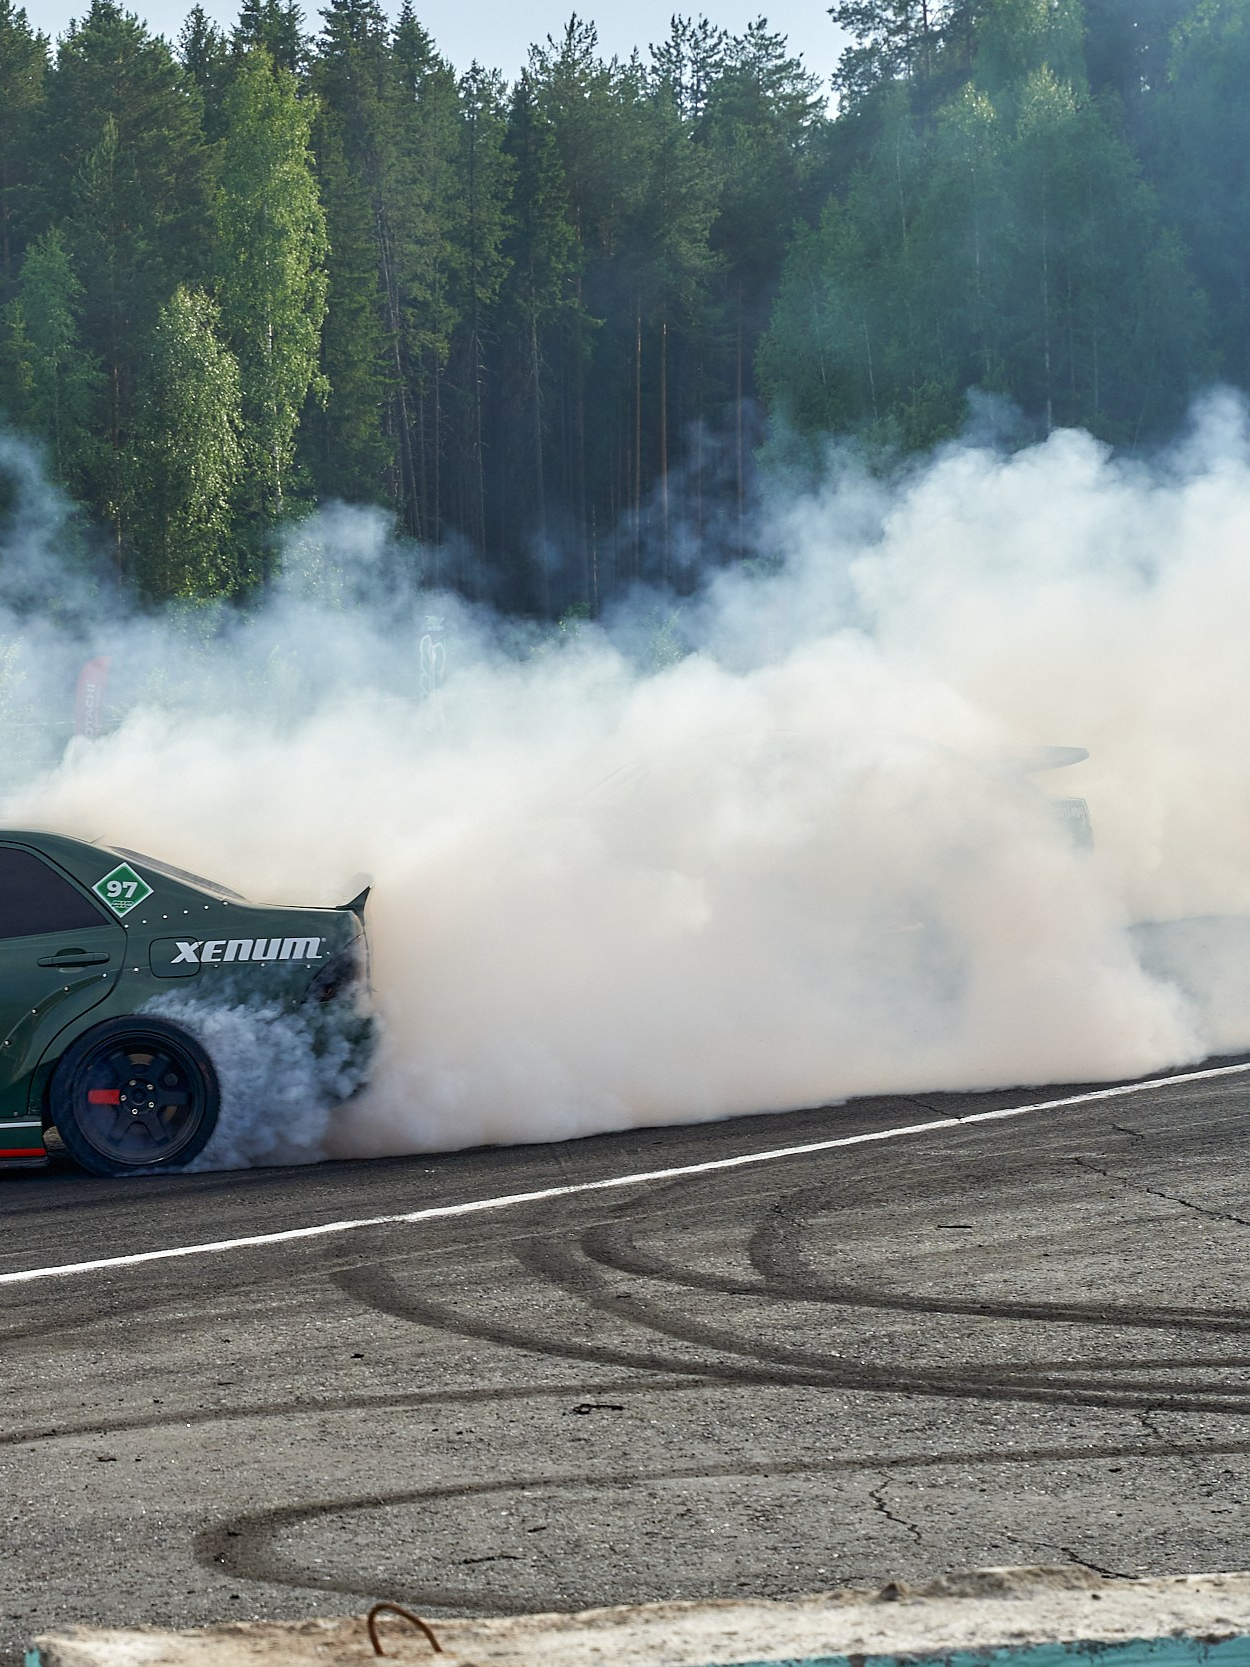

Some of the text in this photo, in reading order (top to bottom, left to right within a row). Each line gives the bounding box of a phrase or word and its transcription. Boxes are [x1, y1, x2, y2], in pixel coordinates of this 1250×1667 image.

[85, 683, 96, 737] OTACHI
[106, 880, 138, 898] 97
[170, 937, 324, 965] XENUM
